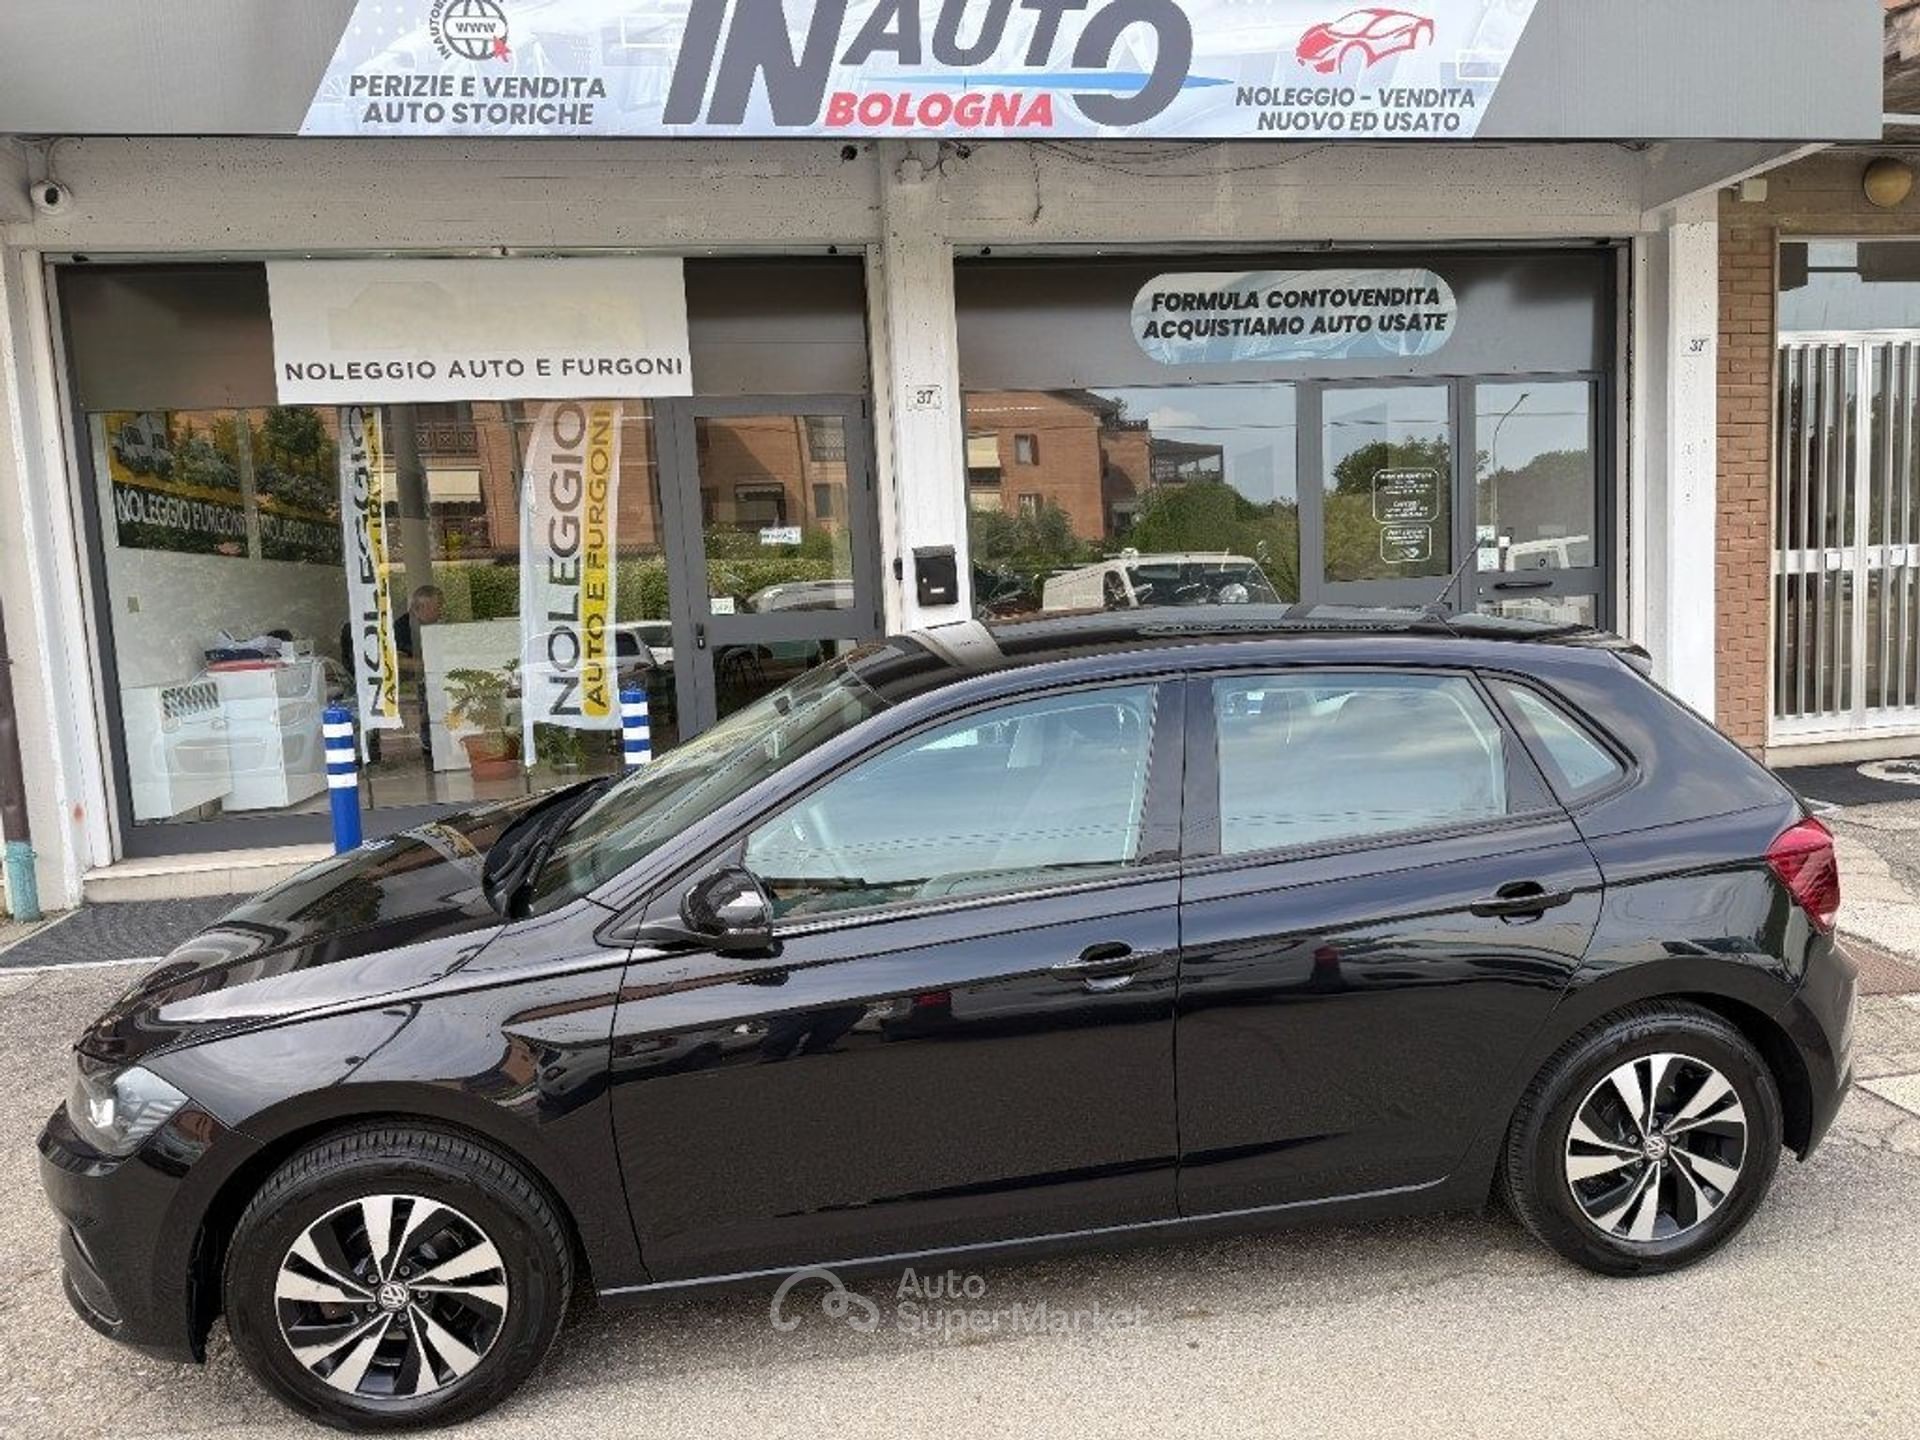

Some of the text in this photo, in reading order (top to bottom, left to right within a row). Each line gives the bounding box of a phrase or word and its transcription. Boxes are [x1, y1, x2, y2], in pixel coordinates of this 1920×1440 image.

[349, 75, 606, 98] PERIZIE E VENDITA
[1235, 87, 1355, 107] NOLEGGIO
[1379, 89, 1475, 108] VENDITA
[362, 102, 593, 125] AUTO STORICHE
[825, 92, 1053, 127] BOLOGNA
[1257, 112, 1460, 131] NUOVO ED USATO
[1151, 287, 1440, 312] FORMULA CONTOVENDITA
[1143, 312, 1448, 339] ACQUISTIAMO AUTO USATE
[285, 357, 682, 381] NOLEGGIO AUTO E FURGONI
[917, 390, 934, 404] 37
[116, 488, 190, 531] NOLEGGIO
[548, 402, 586, 716] NOLEGGIO
[587, 410, 612, 708] AUTO E FURGONI
